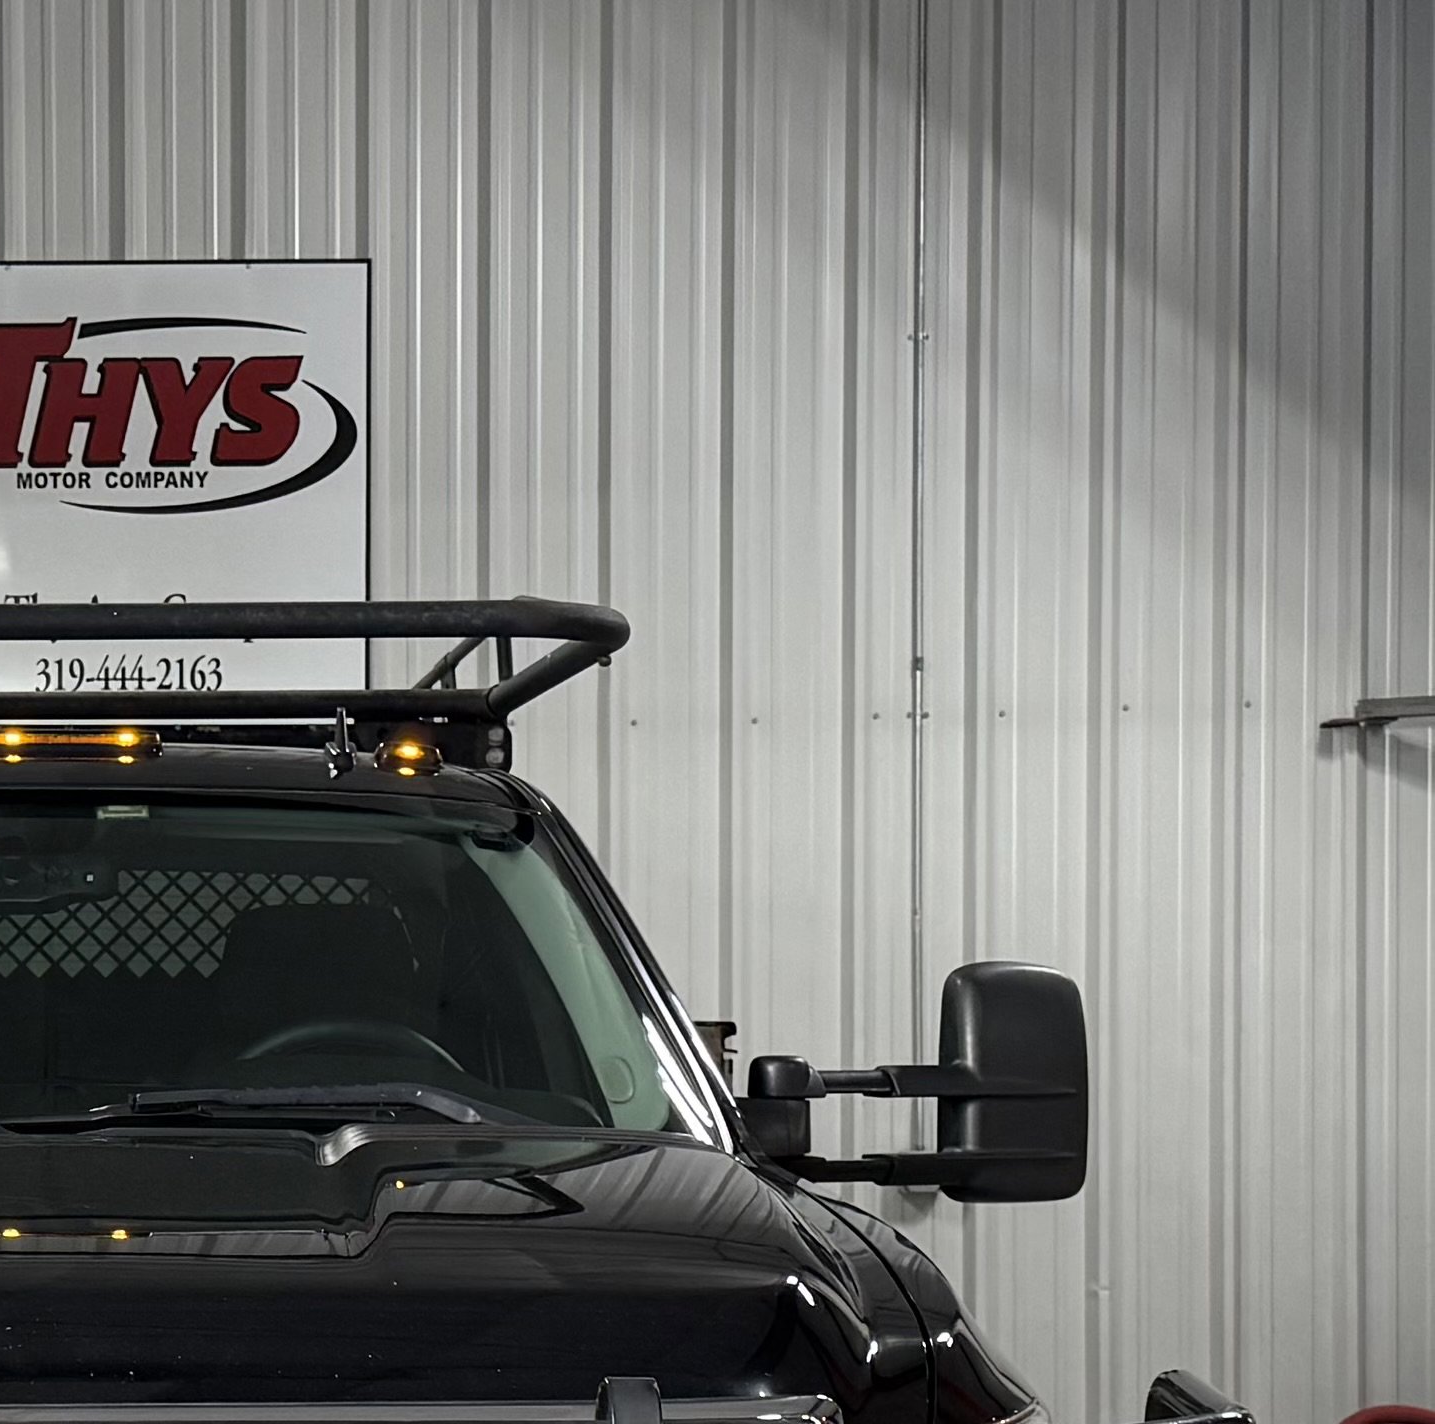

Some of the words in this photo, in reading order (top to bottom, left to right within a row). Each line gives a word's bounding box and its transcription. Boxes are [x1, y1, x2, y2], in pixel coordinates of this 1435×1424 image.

[16, 471, 91, 489] MOTOR
[105, 471, 209, 489] COMPANY
[35, 654, 223, 692] 319-444-2163
